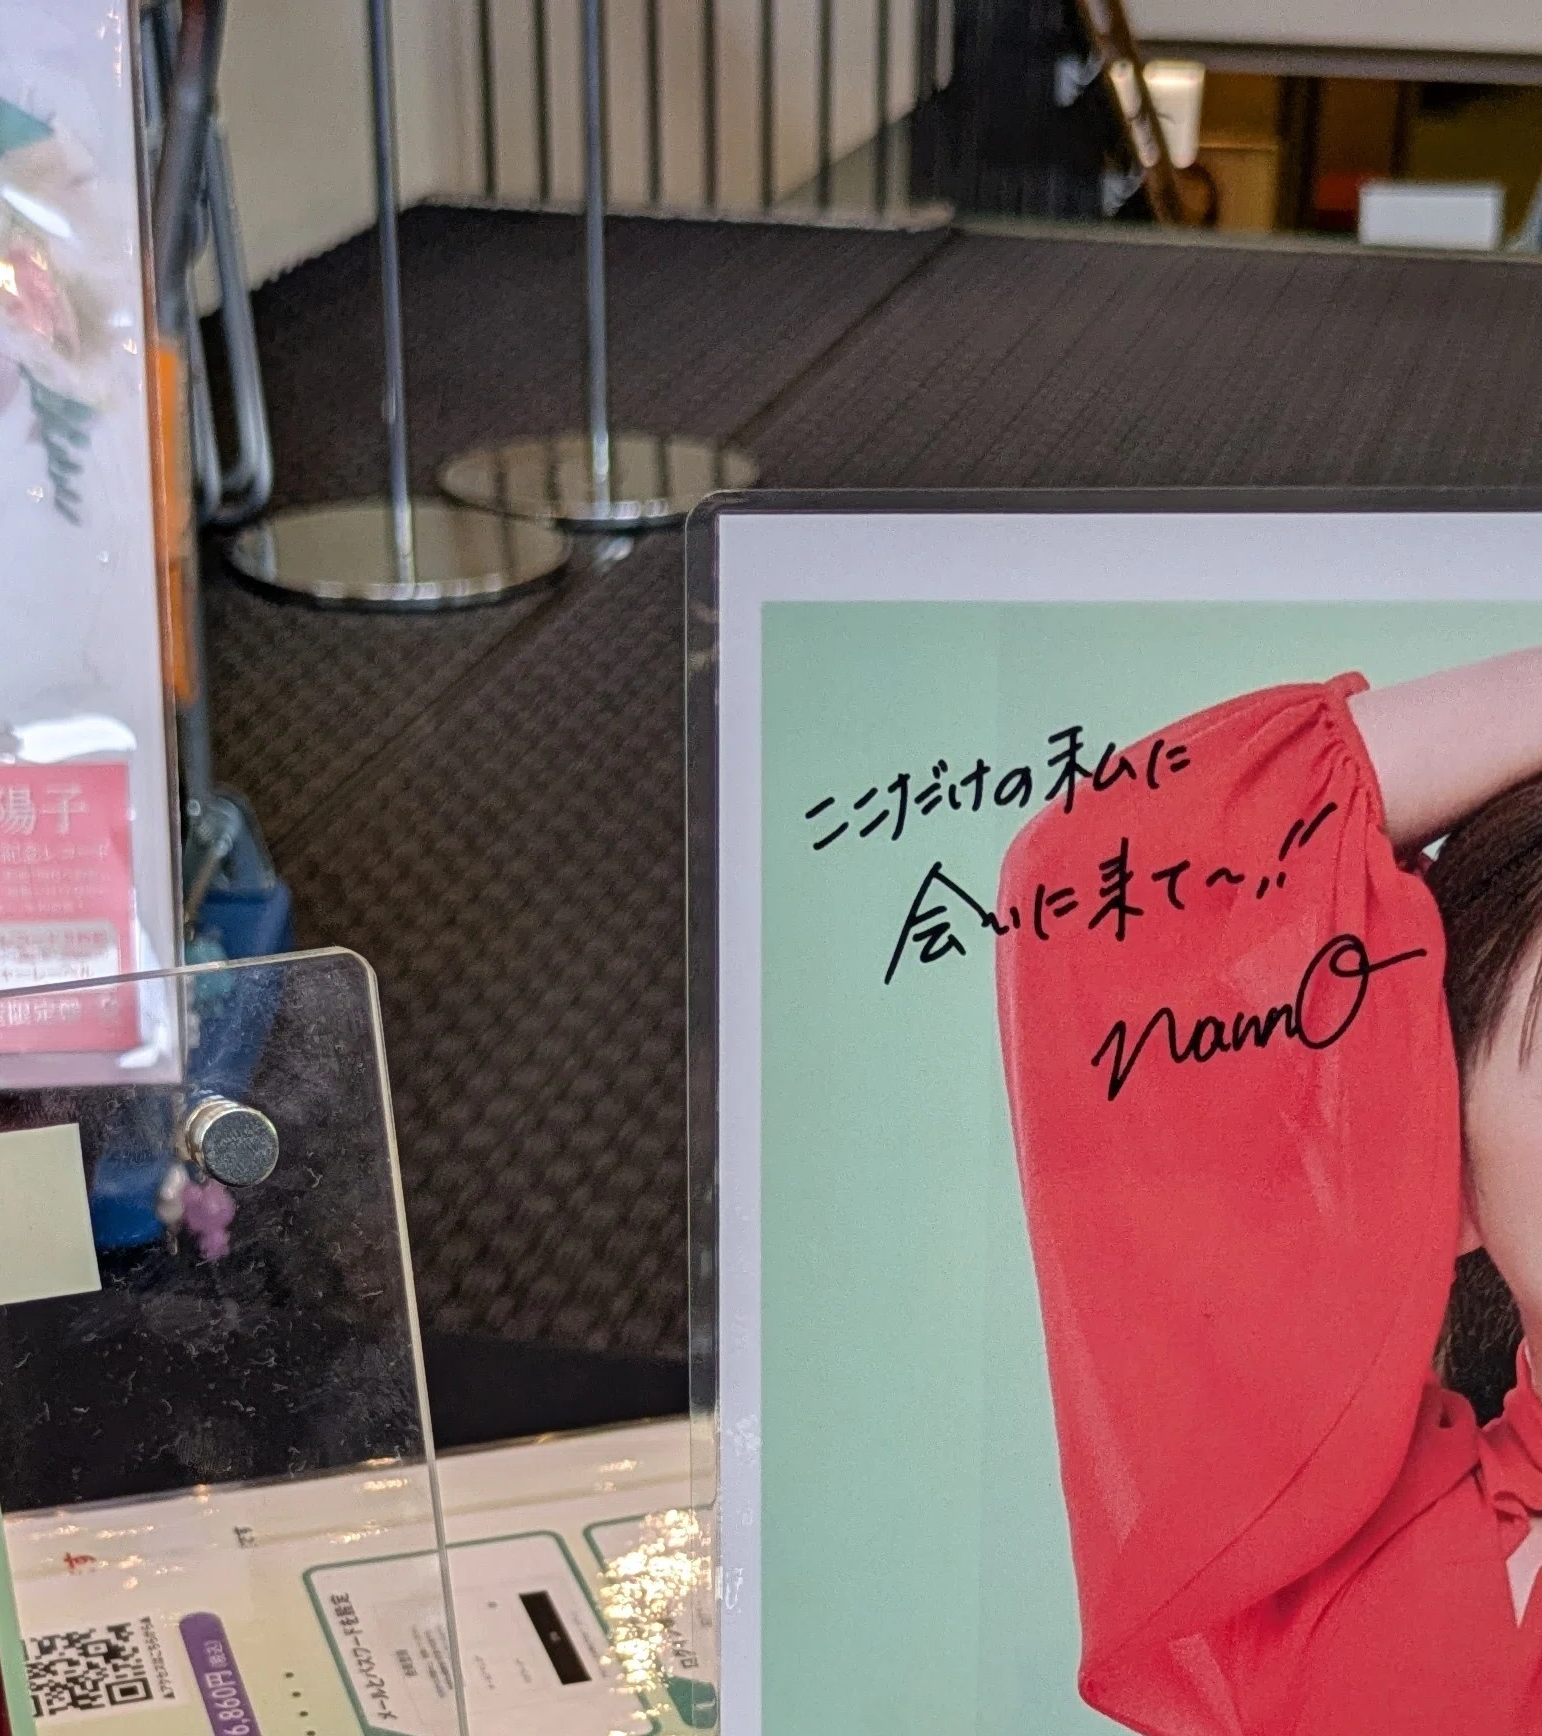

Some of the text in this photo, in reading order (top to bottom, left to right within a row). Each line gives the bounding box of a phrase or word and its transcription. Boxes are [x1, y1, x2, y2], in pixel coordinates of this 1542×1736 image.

[804, 724, 1192, 850] ここだけの私に
